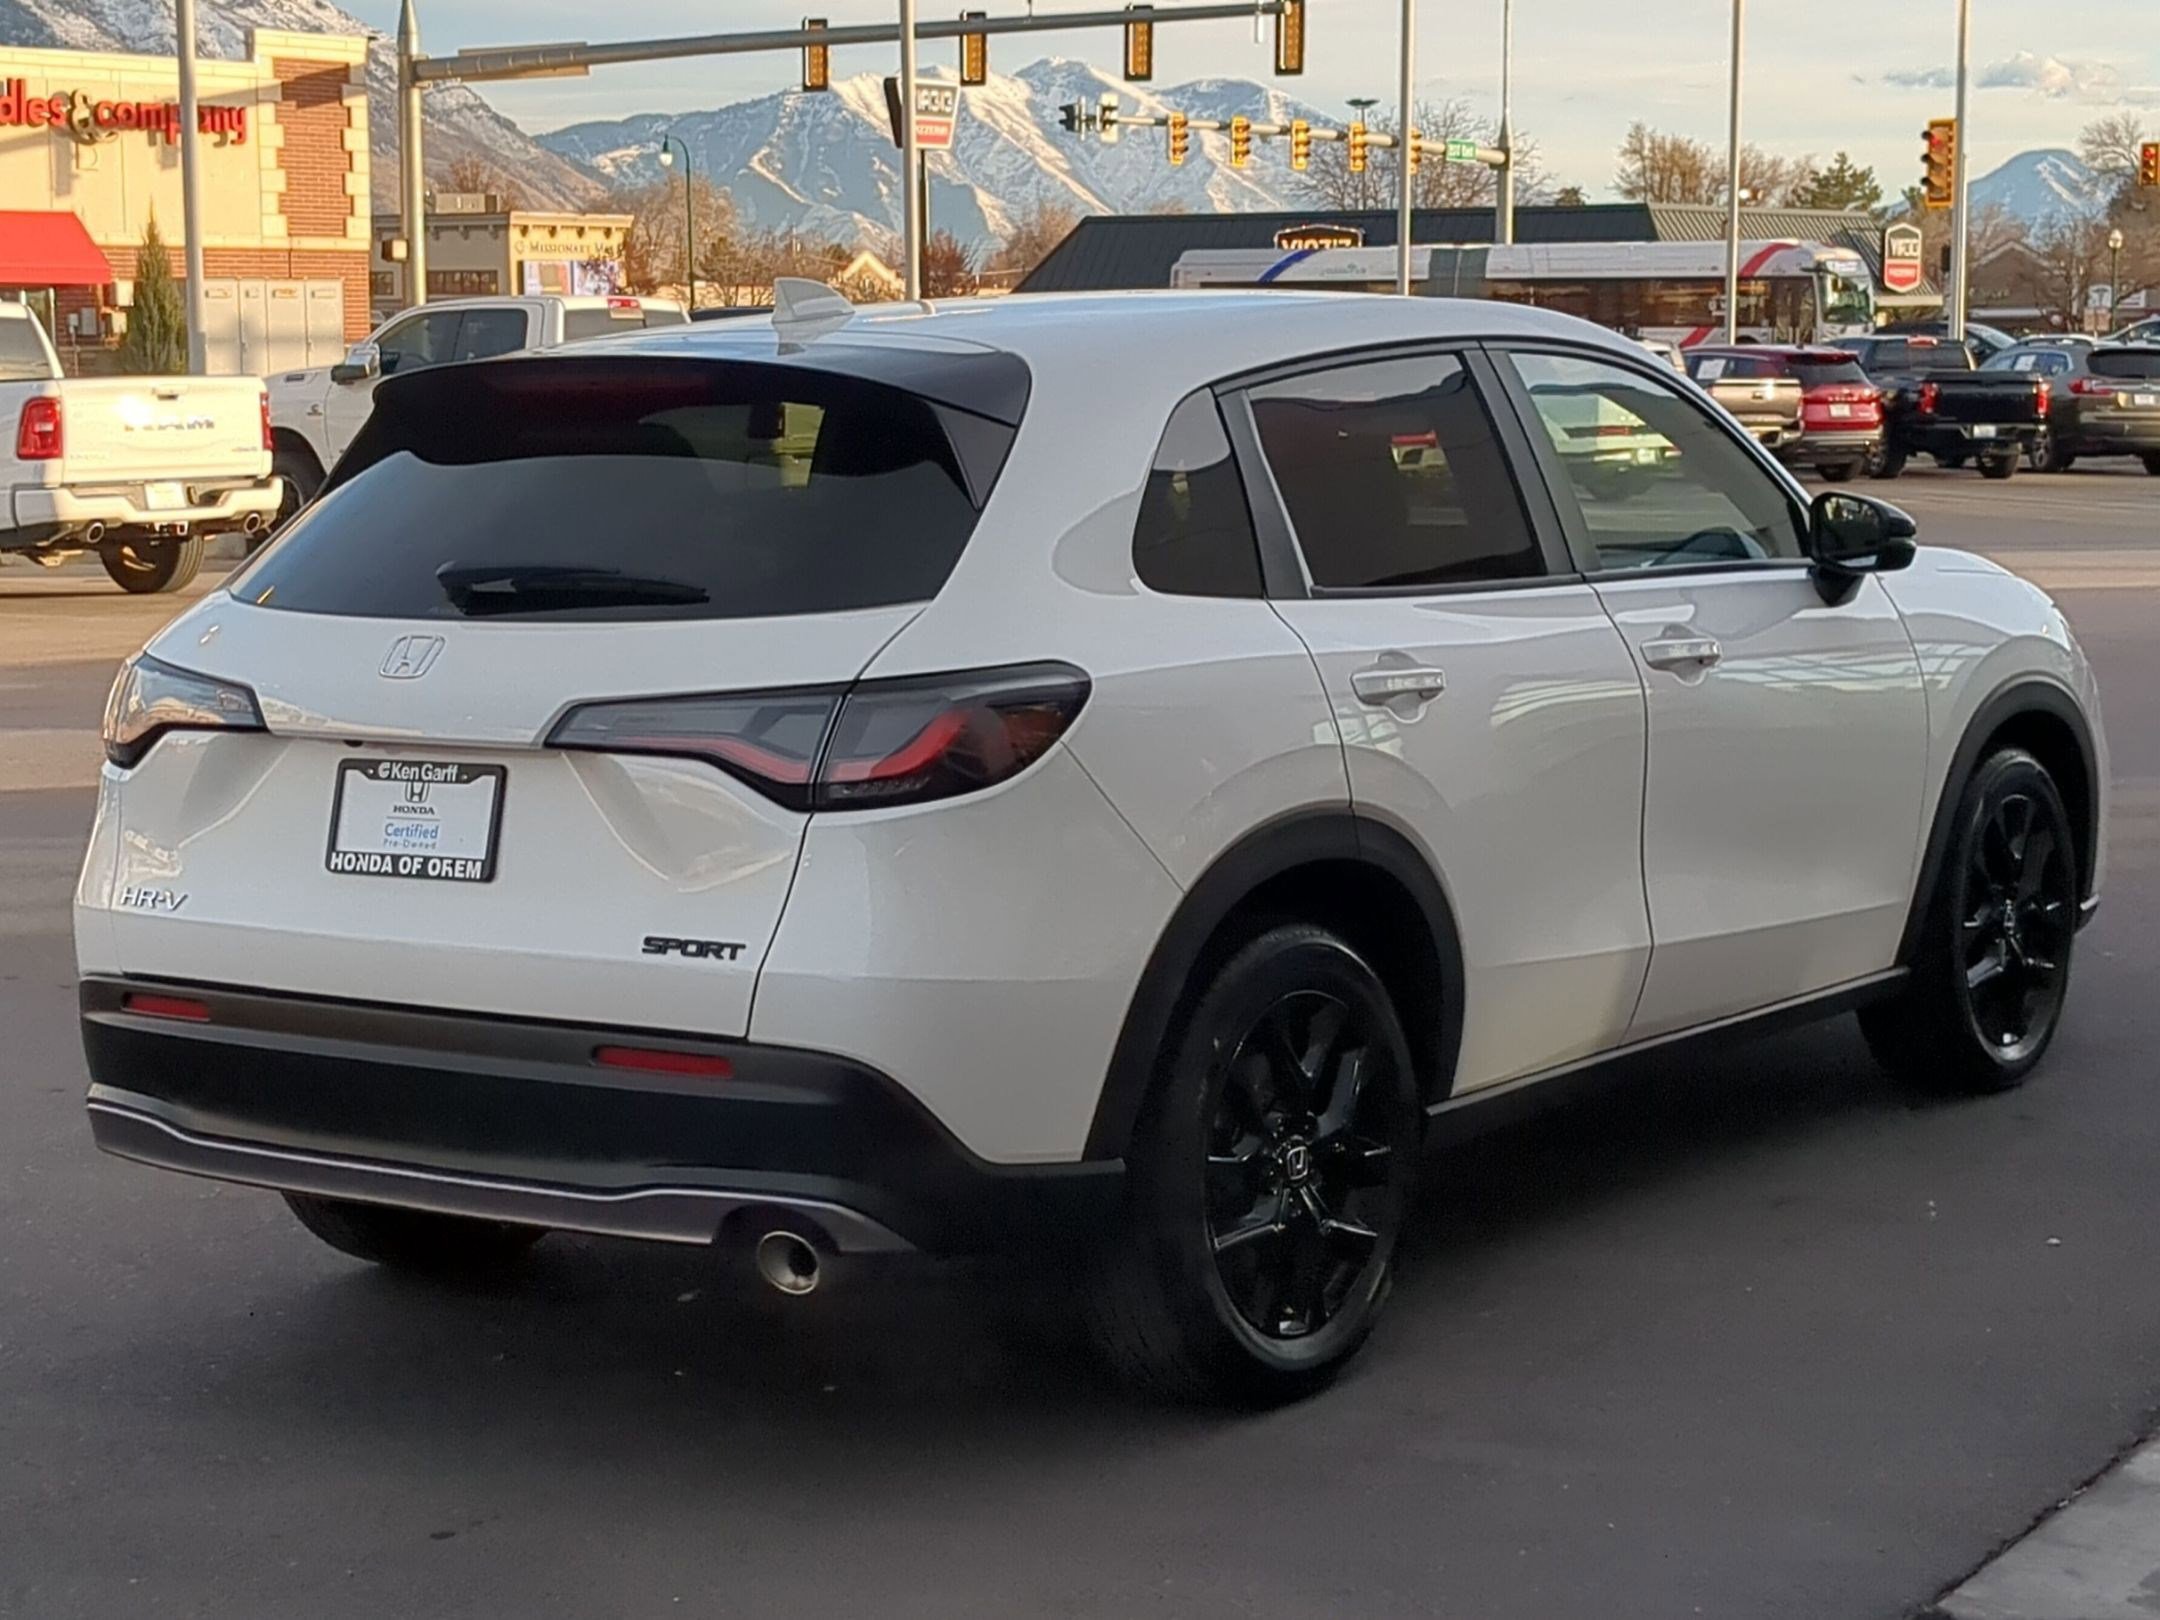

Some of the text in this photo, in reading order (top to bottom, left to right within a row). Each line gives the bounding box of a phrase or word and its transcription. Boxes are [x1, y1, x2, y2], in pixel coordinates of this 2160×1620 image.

[391, 762, 458, 782] Ken Garff
[393, 805, 435, 815] HONDA
[384, 823, 439, 839] Certified
[383, 838, 437, 850] Pre-Owned
[330, 852, 482, 880] HONDA OF OREM
[121, 887, 189, 911] HR-V
[641, 936, 747, 960] SPORT
